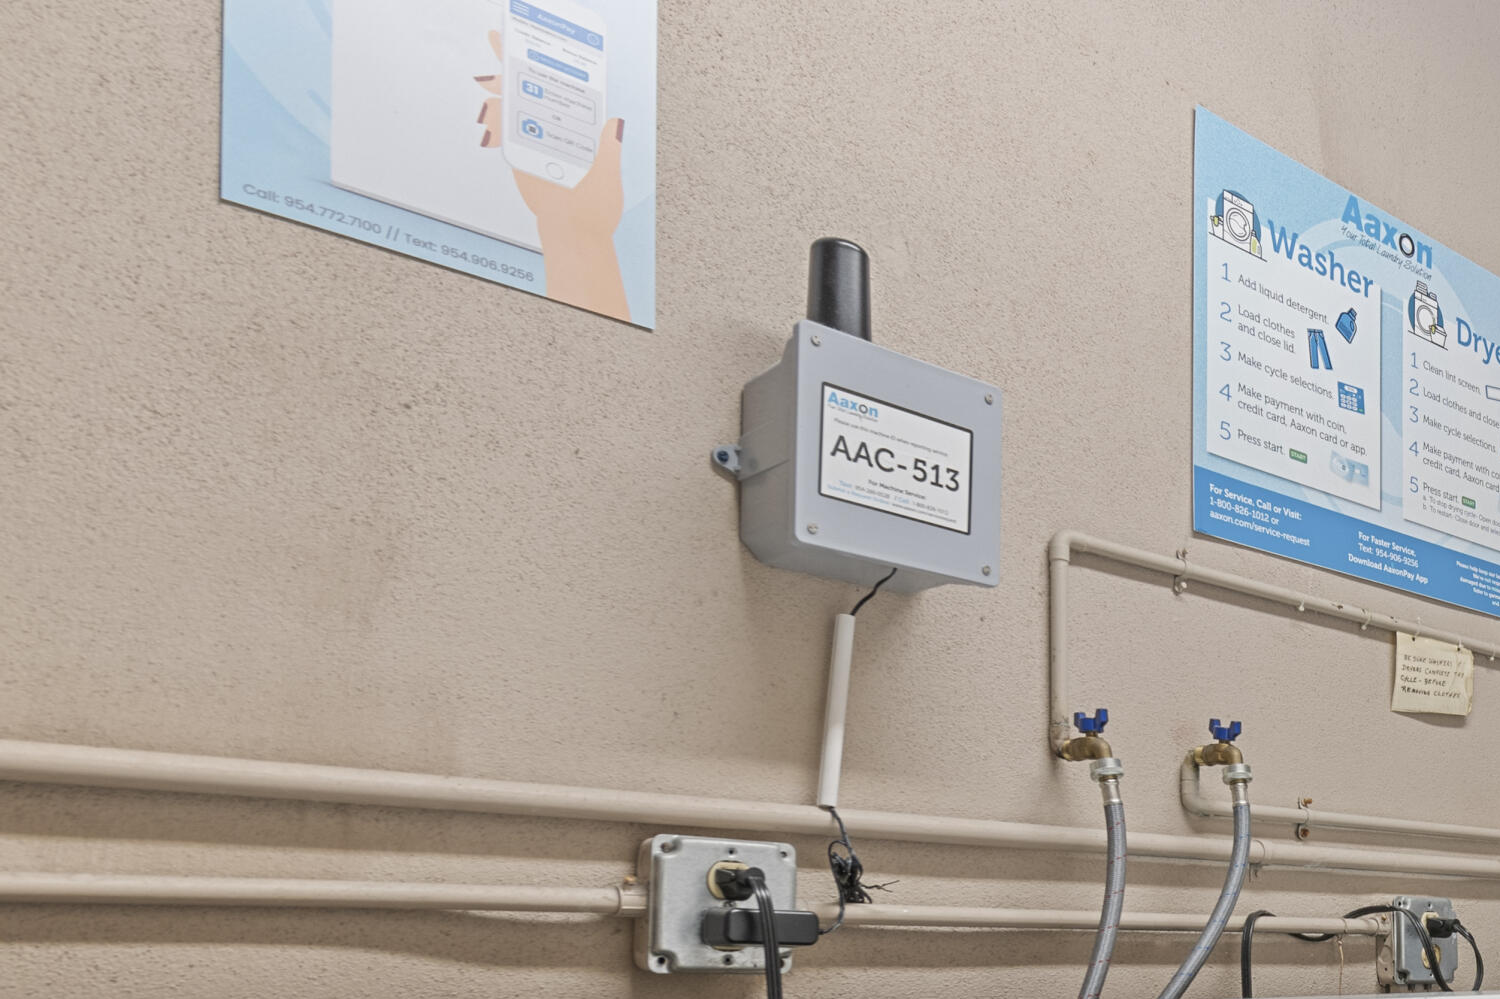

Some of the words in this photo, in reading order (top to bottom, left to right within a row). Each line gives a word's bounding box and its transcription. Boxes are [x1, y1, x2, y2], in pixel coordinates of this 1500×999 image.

[242, 183, 280, 204] Call:
[284, 196, 382, 234] 954.772.7100
[404, 232, 438, 253] Text:
[441, 244, 534, 282] 954.906.9256
[1341, 194, 1432, 269] Aaxon
[1268, 218, 1373, 298] Washer
[1341, 225, 1357, 241] Your
[1359, 233, 1376, 251] Total
[1376, 246, 1403, 269] Laundry
[1404, 260, 1432, 281] Solution
[1222, 263, 1231, 282] 1
[1238, 274, 1256, 291] Add
[1259, 283, 1284, 304] liquid
[1286, 297, 1329, 325] detergent.
[1220, 302, 1232, 323] 2
[1238, 304, 1260, 323] Load
[1263, 313, 1295, 338] clothes
[1238, 322, 1256, 337] and
[1258, 329, 1281, 347] close
[1284, 339, 1296, 354] lid.
[1220, 342, 1232, 361] 3
[1238, 352, 1262, 370] Make
[1265, 364, 1288, 382] cycle
[1290, 375, 1335, 400] selections.
[1411, 352, 1418, 369] 1
[1423, 360, 1443, 377] Clean
[1445, 369, 1456, 383] lint
[828, 391, 879, 418] Aaxon
[1219, 383, 1232, 402] 4
[1238, 382, 1262, 401] Make
[1265, 395, 1303, 416] payment
[1306, 409, 1324, 425] with
[1409, 378, 1419, 396] 2
[1423, 386, 1440, 402] Load
[1442, 397, 1467, 415] clothes
[1469, 409, 1482, 421] and
[1483, 415, 1500, 429] close
[1220, 421, 1231, 440] 5
[1238, 428, 1261, 447] Press
[1264, 439, 1285, 455] start.
[1237, 400, 1263, 417] credit
[1290, 420, 1317, 437] Aaxon
[1319, 430, 1337, 445] card
[1340, 438, 1349, 448] or
[1351, 443, 1368, 456] app.
[1409, 405, 1418, 423] 3
[1423, 414, 1442, 430] Make
[1444, 424, 1461, 439] cycle
[830, 435, 959, 492] AAC-513
[1409, 441, 1419, 456] 4
[1423, 442, 1442, 456] Make
[1443, 451, 1474, 470] payment
[1475, 463, 1490, 477] with
[1423, 457, 1443, 471] credit
[1463, 472, 1484, 487] Aaxon
[1485, 481, 1499, 493] card
[1209, 483, 1222, 496] For
[1257, 499, 1272, 512] Call
[1274, 505, 1281, 514] or
[1283, 506, 1302, 521] Visit:
[1410, 476, 1418, 493] 5
[1423, 482, 1441, 497] Press
[1209, 496, 1269, 524] 1-800-826-1012
[1271, 517, 1279, 525] or
[1209, 509, 1310, 546] aaxon.com/service-request
[1358, 531, 1369, 542] For
[1371, 535, 1390, 548] Faster
[1358, 543, 1373, 554] Text:
[1376, 547, 1419, 568] 954-906-9256
[1348, 553, 1382, 570] Download
[1384, 563, 1414, 581] AaxonPay
[1416, 574, 1428, 584] App
